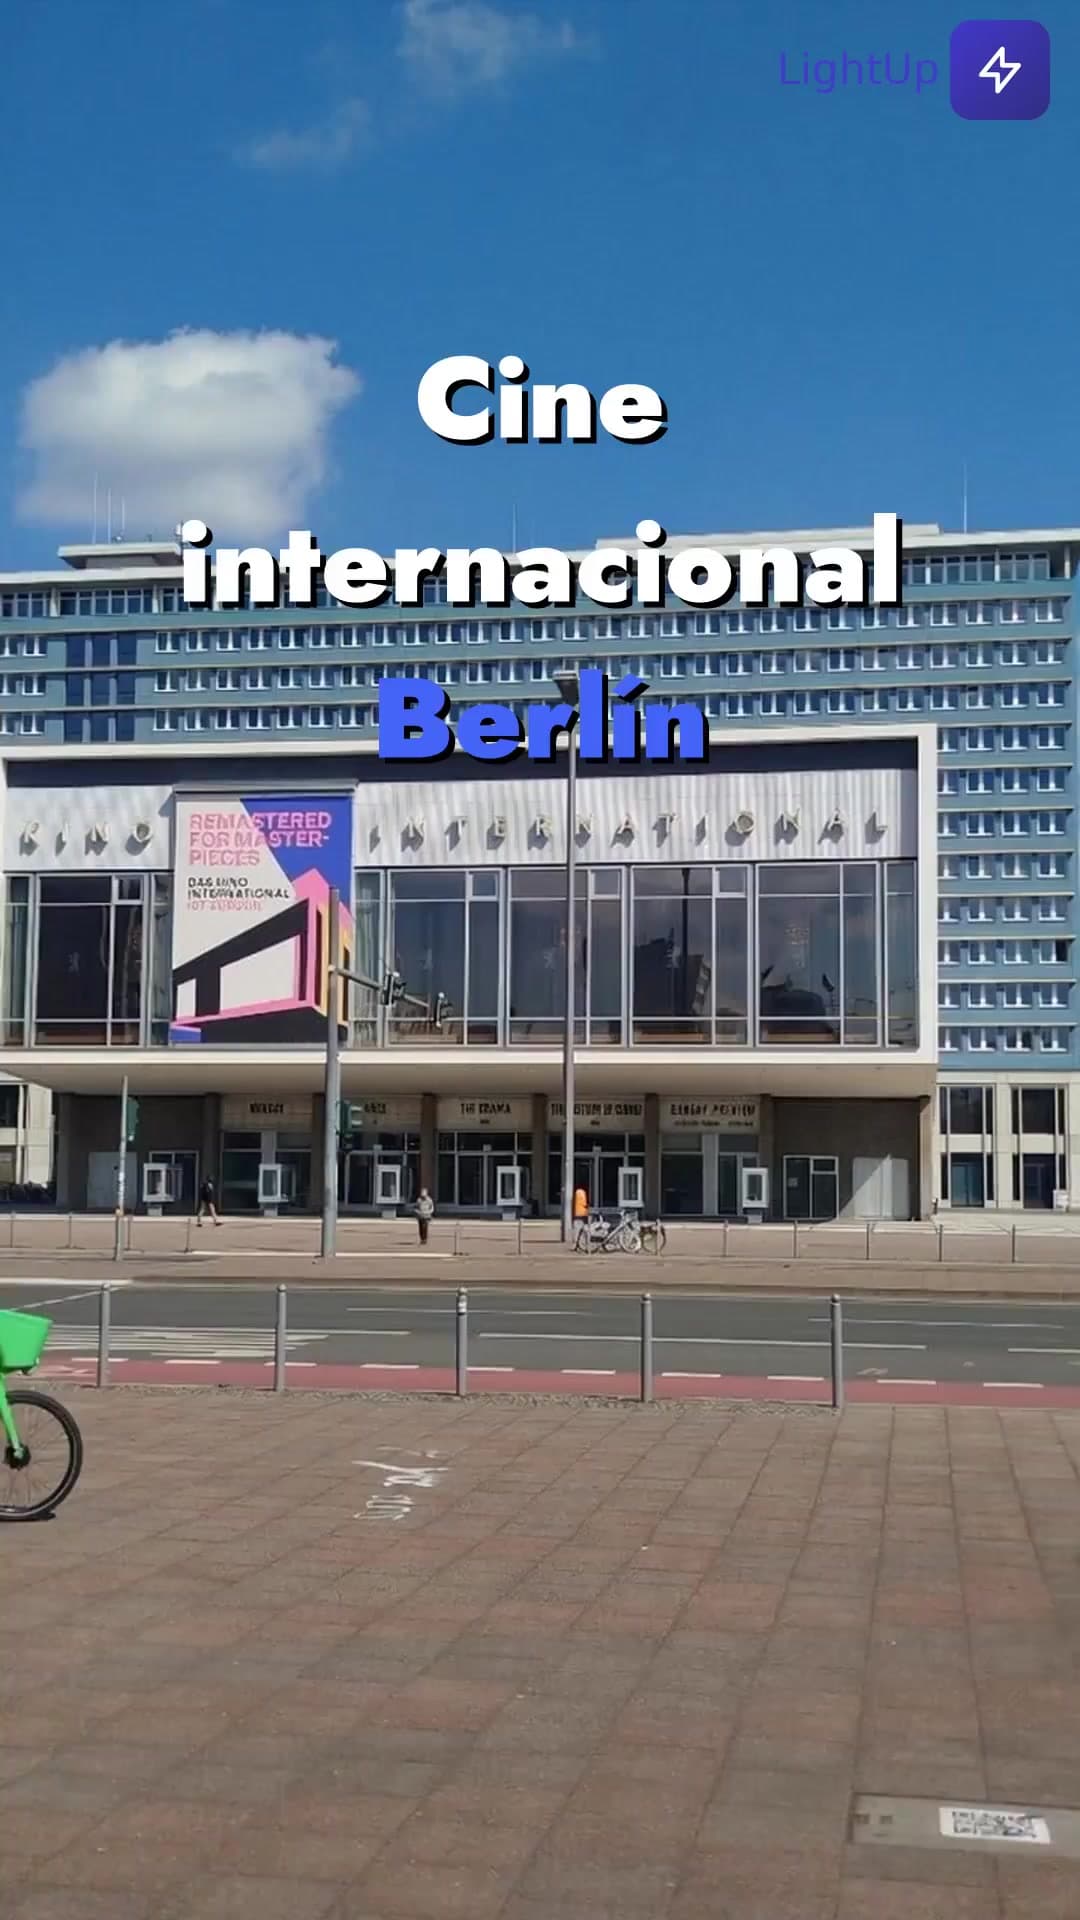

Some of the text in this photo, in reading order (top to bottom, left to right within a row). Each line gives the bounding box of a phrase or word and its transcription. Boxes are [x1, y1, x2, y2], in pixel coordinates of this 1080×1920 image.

[189, 811, 332, 830] REMASTERED
[371, 807, 889, 842] INTERNATIONAL
[189, 829, 330, 849] FOR MASTER-
[189, 849, 261, 866] PIECES
[187, 887, 290, 900] INTERNATIONAL
